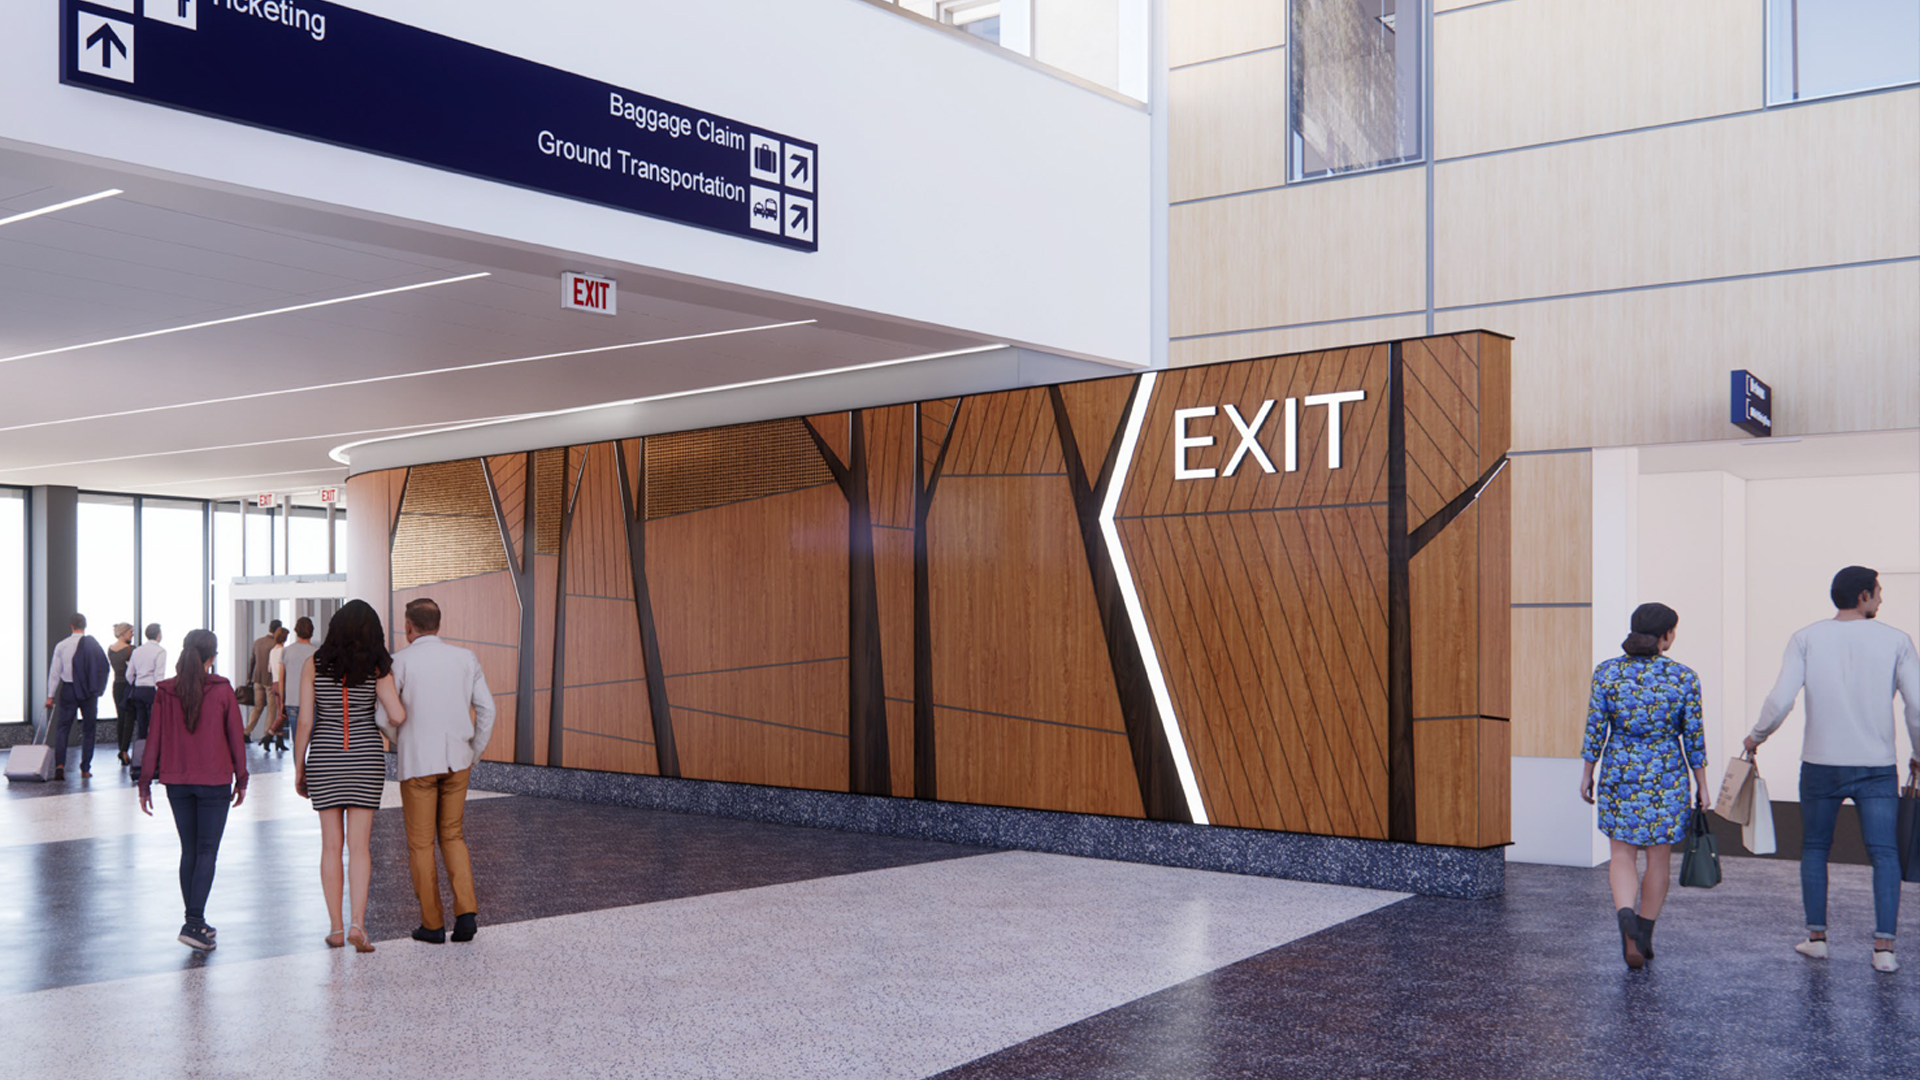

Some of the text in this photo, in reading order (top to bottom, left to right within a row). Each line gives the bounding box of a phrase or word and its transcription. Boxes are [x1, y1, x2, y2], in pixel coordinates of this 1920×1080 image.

[213, 0, 325, 41] cketing
[610, 92, 745, 151] Baggage Claim
[538, 130, 745, 203] Ground Transportation
[574, 277, 610, 310] EXIT
[1174, 390, 1366, 480] EXIT
[260, 494, 273, 507] EXIT
[322, 489, 336, 502] EXIT
